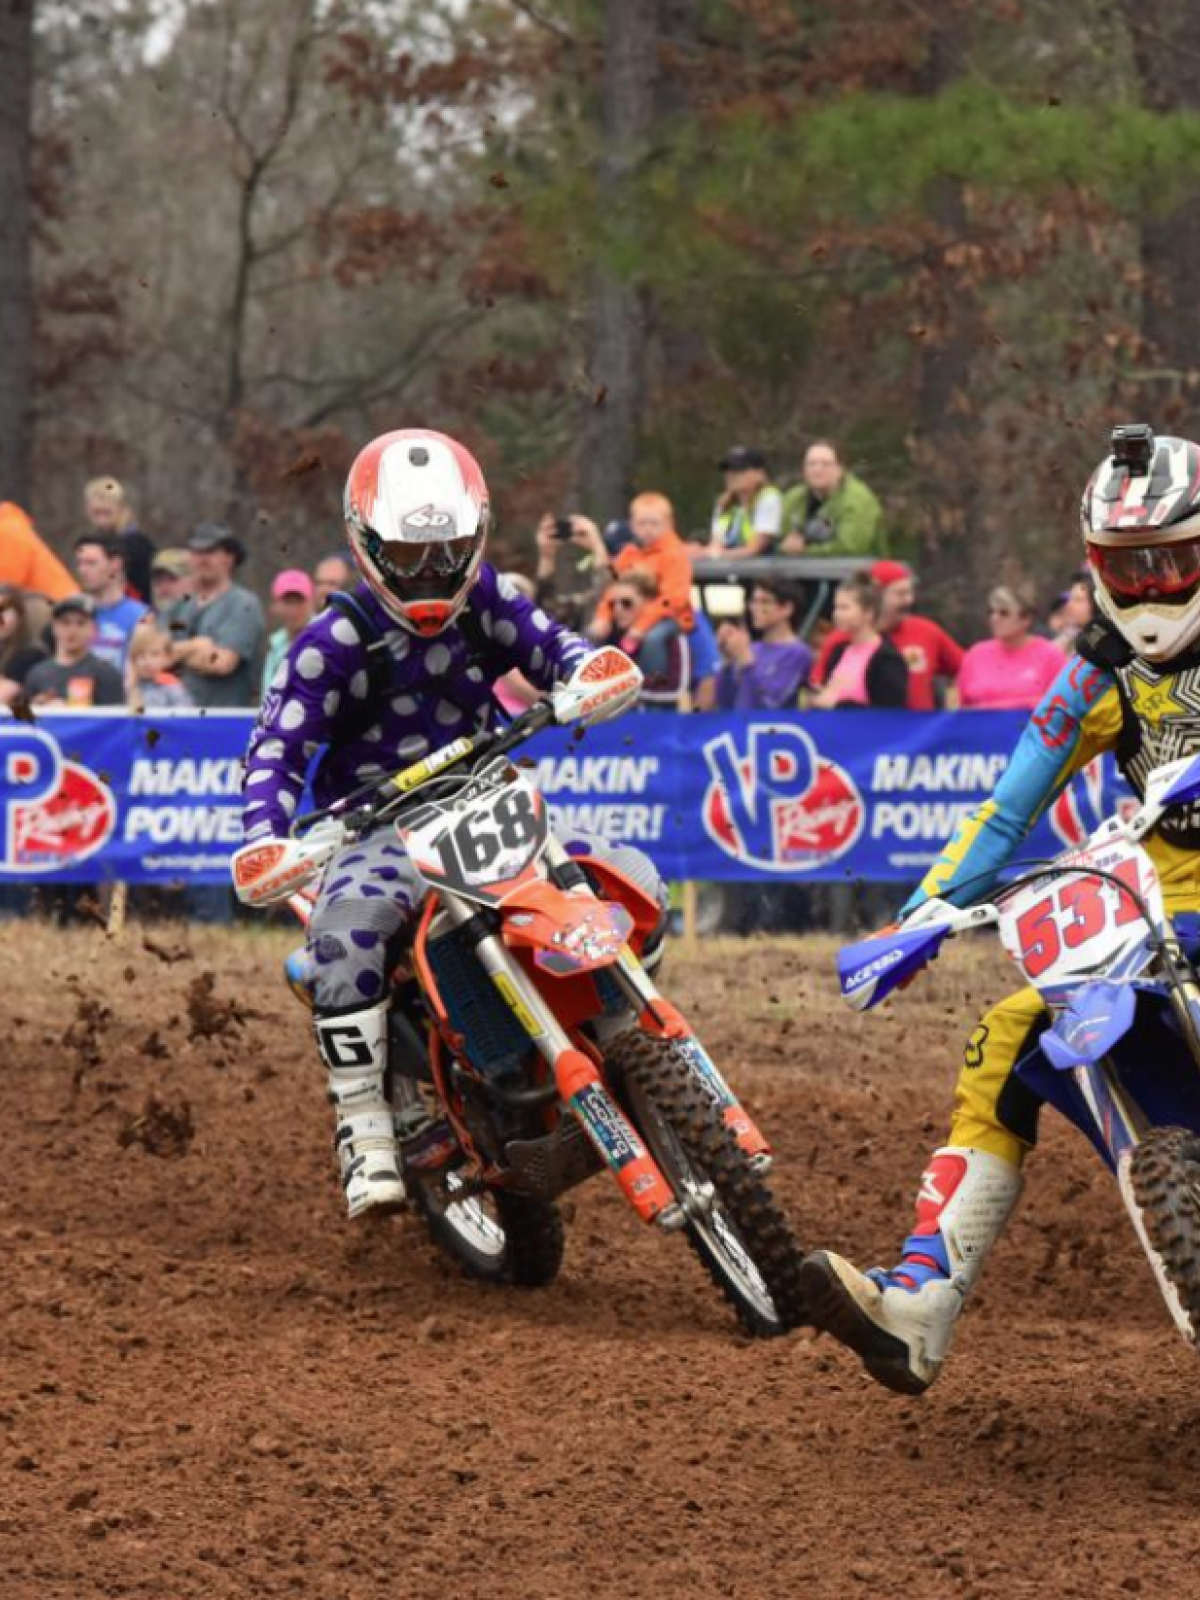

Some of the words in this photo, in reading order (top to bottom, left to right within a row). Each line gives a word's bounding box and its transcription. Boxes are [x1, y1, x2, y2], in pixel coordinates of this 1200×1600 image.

[130, 758, 246, 795] MAKI
[872, 754, 1007, 792] MAKIN'
[703, 723, 818, 872] VP
[124, 806, 247, 843] POWE
[429, 787, 537, 884] 168
[546, 803, 668, 841] OWER!
[1016, 856, 1140, 979] 531
